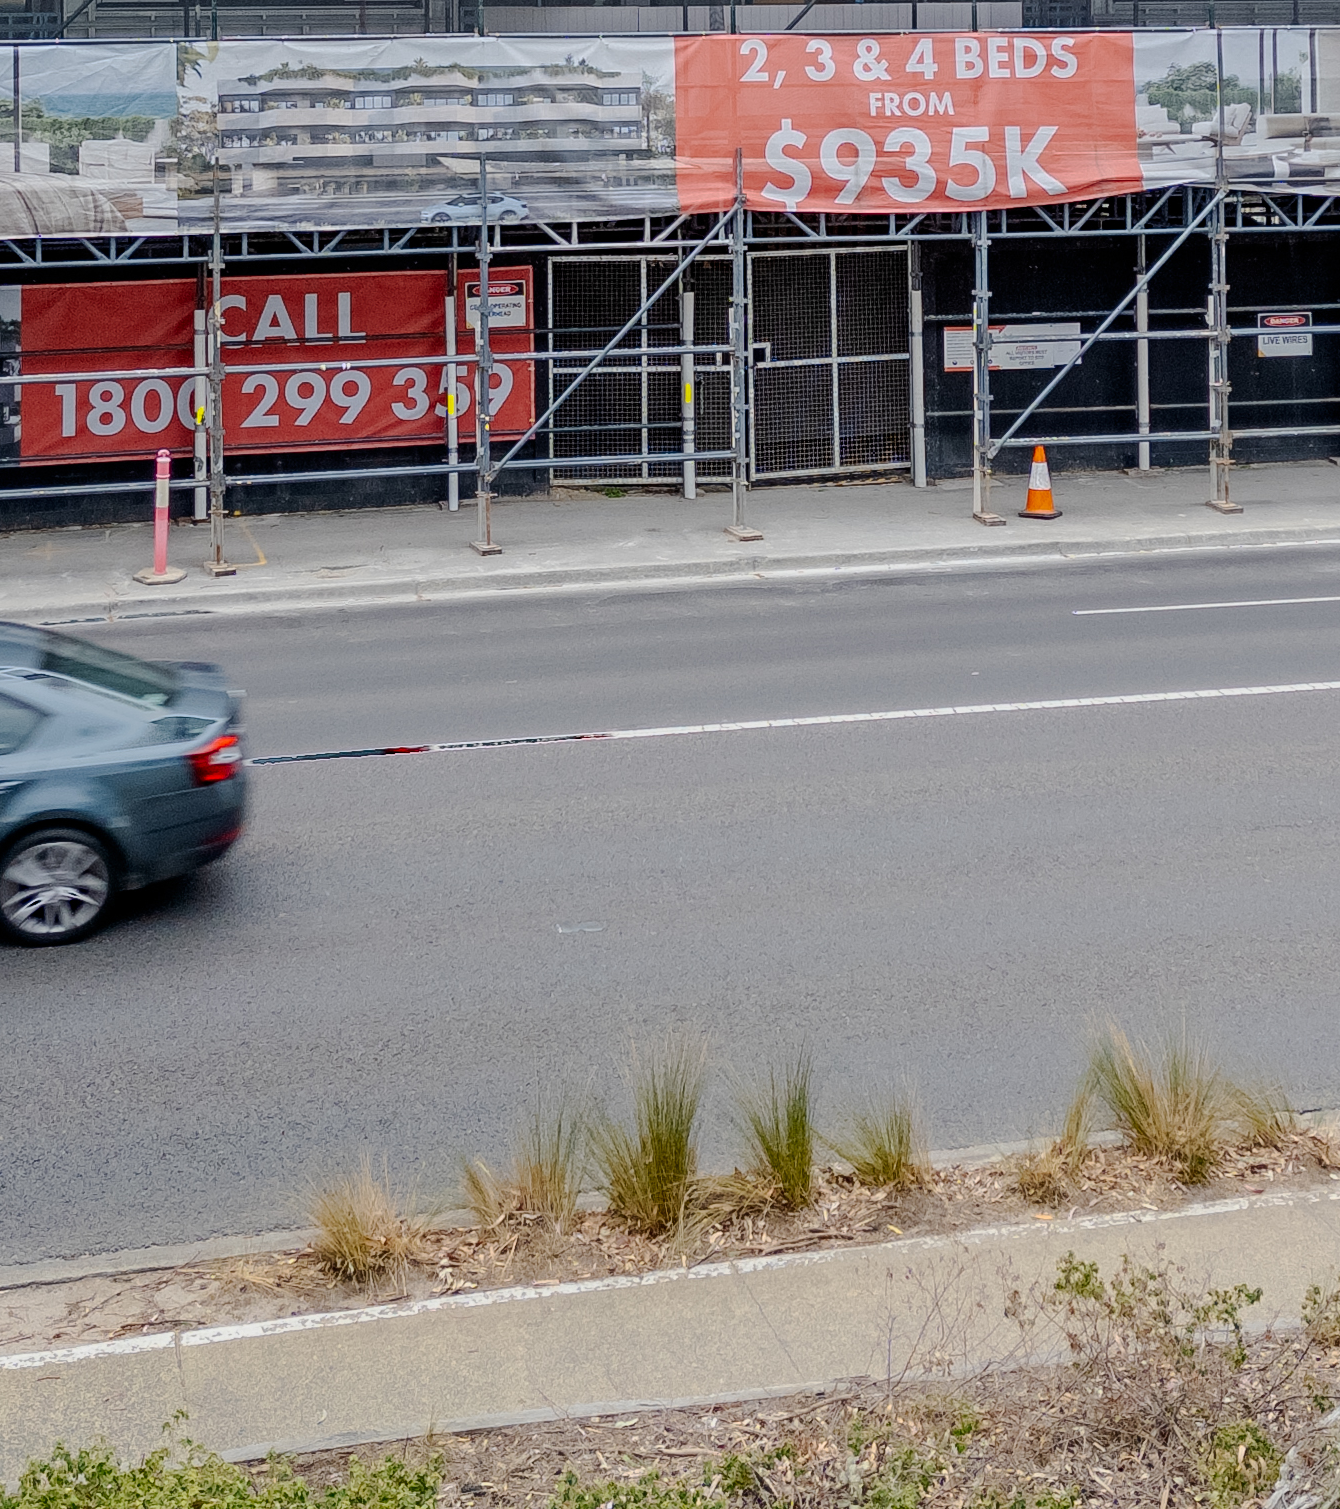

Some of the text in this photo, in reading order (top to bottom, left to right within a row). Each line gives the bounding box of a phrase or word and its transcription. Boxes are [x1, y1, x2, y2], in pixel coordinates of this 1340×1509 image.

[739, 37, 1078, 89] 2, 3 & 4 BEDS
[869, 91, 955, 117] FROM
[760, 118, 1069, 212] $935K
[207, 292, 366, 349] CALL
[1262, 335, 1308, 345] LIVE WIRES
[239, 370, 372, 428] 299
[391, 362, 514, 422] 359
